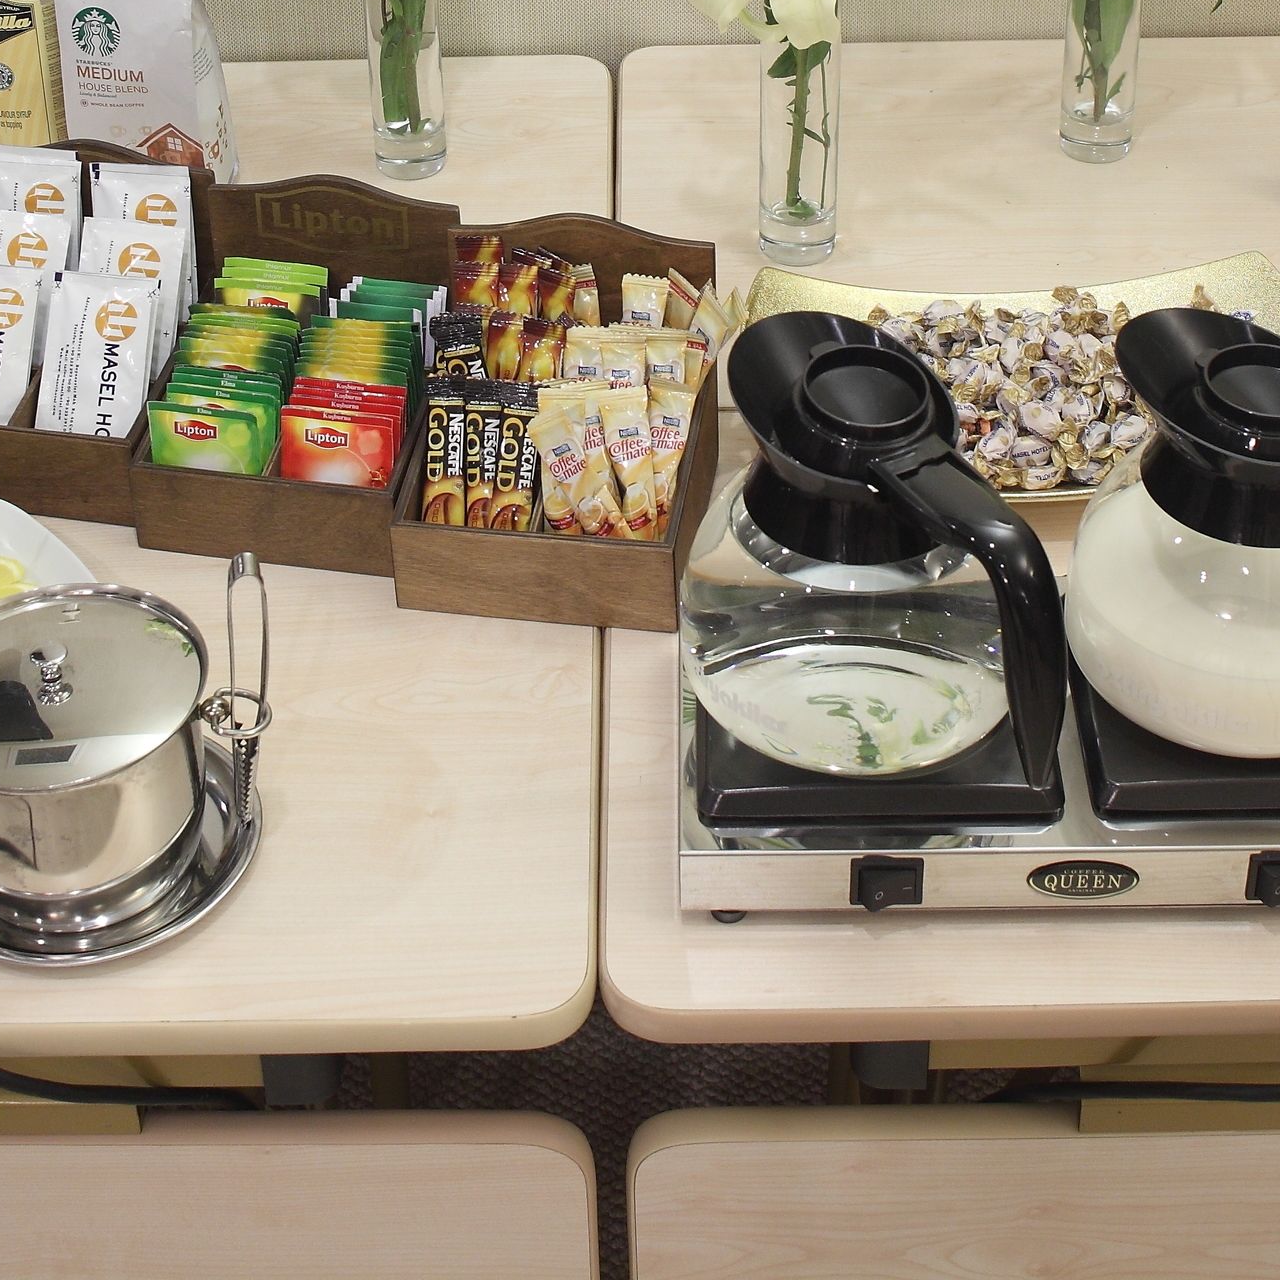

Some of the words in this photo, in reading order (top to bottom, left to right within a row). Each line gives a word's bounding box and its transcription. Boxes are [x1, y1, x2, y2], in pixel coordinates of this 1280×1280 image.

[76, 65, 145, 83] MEDIUM
[79, 82, 112, 92] HOUSE
[271, 201, 397, 246] Lipton
[97, 343, 120, 407] MASEL
[177, 424, 215, 438] Lipton
[307, 430, 345, 447] Lipton
[427, 407, 448, 483] GOLD
[466, 412, 483, 488] GOLD
[622, 445, 651, 461] mate
[656, 439, 685, 450] mate
[1031, 446, 1048, 455] HOTEL
[497, 417, 524, 493] GOLD
[562, 459, 587, 480] mate
[1044, 874, 1122, 892] QUEEN
